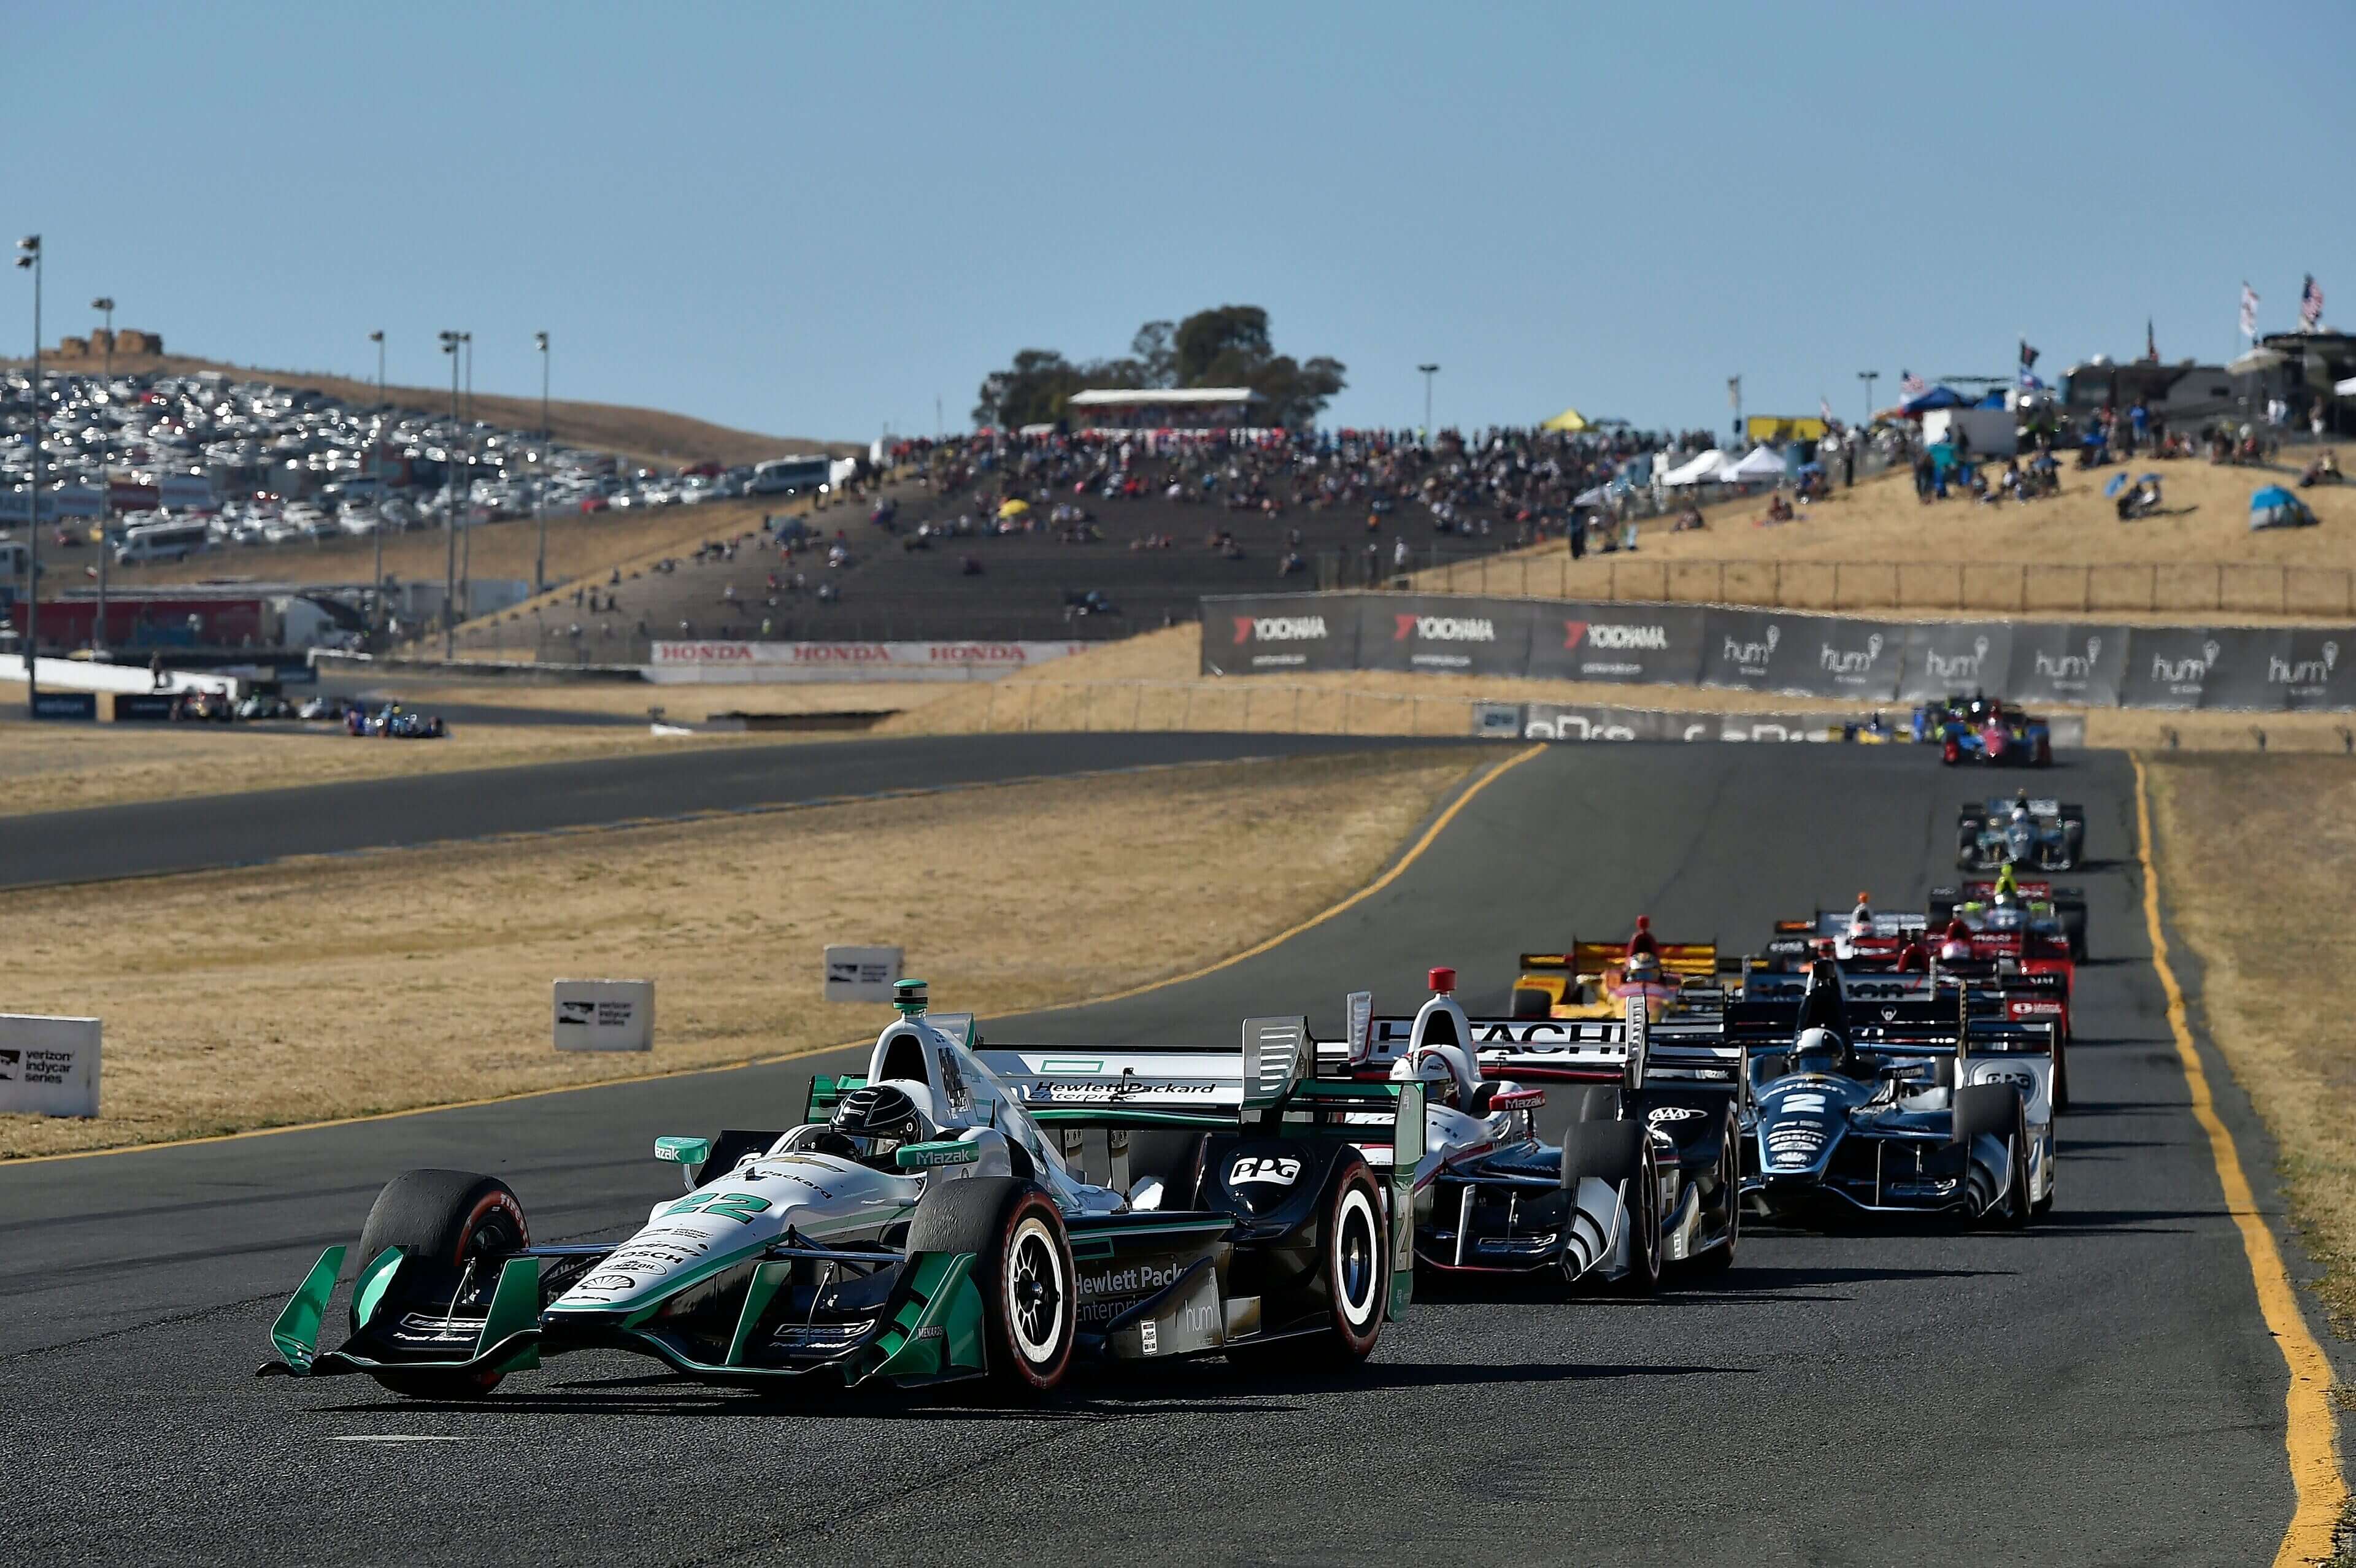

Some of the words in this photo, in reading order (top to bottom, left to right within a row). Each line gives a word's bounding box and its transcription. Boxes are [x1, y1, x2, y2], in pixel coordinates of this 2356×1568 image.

[661, 646, 754, 659] HONDA
[793, 647, 891, 661] HONDA
[929, 647, 1026, 660] HONDA
[1723, 634, 1769, 664] hum
[1820, 642, 1870, 672] hum
[1926, 647, 1977, 675] hum
[2036, 648, 2088, 675] hum
[2150, 653, 2205, 682] hum
[2268, 654, 2328, 683] hum
[1379, 1023, 1626, 1055] HACHI
[26, 1050, 70, 1061] verizon
[26, 1061, 71, 1074] indycar
[25, 1072, 62, 1084] series
[1035, 1082, 1126, 1093] Hewlett
[1126, 1083, 1216, 1094] Packard
[1505, 1095, 1542, 1109] Mazak
[1781, 1093, 1826, 1113] 2
[655, 1147, 680, 1161] azak
[916, 1149, 971, 1165] Mazak
[1230, 1158, 1301, 1185] PPG
[655, 1193, 773, 1225] 22
[1141, 1263, 1188, 1288] Pack
[1185, 1299, 1214, 1332] hum
[918, 1326, 943, 1338] MENARDS
